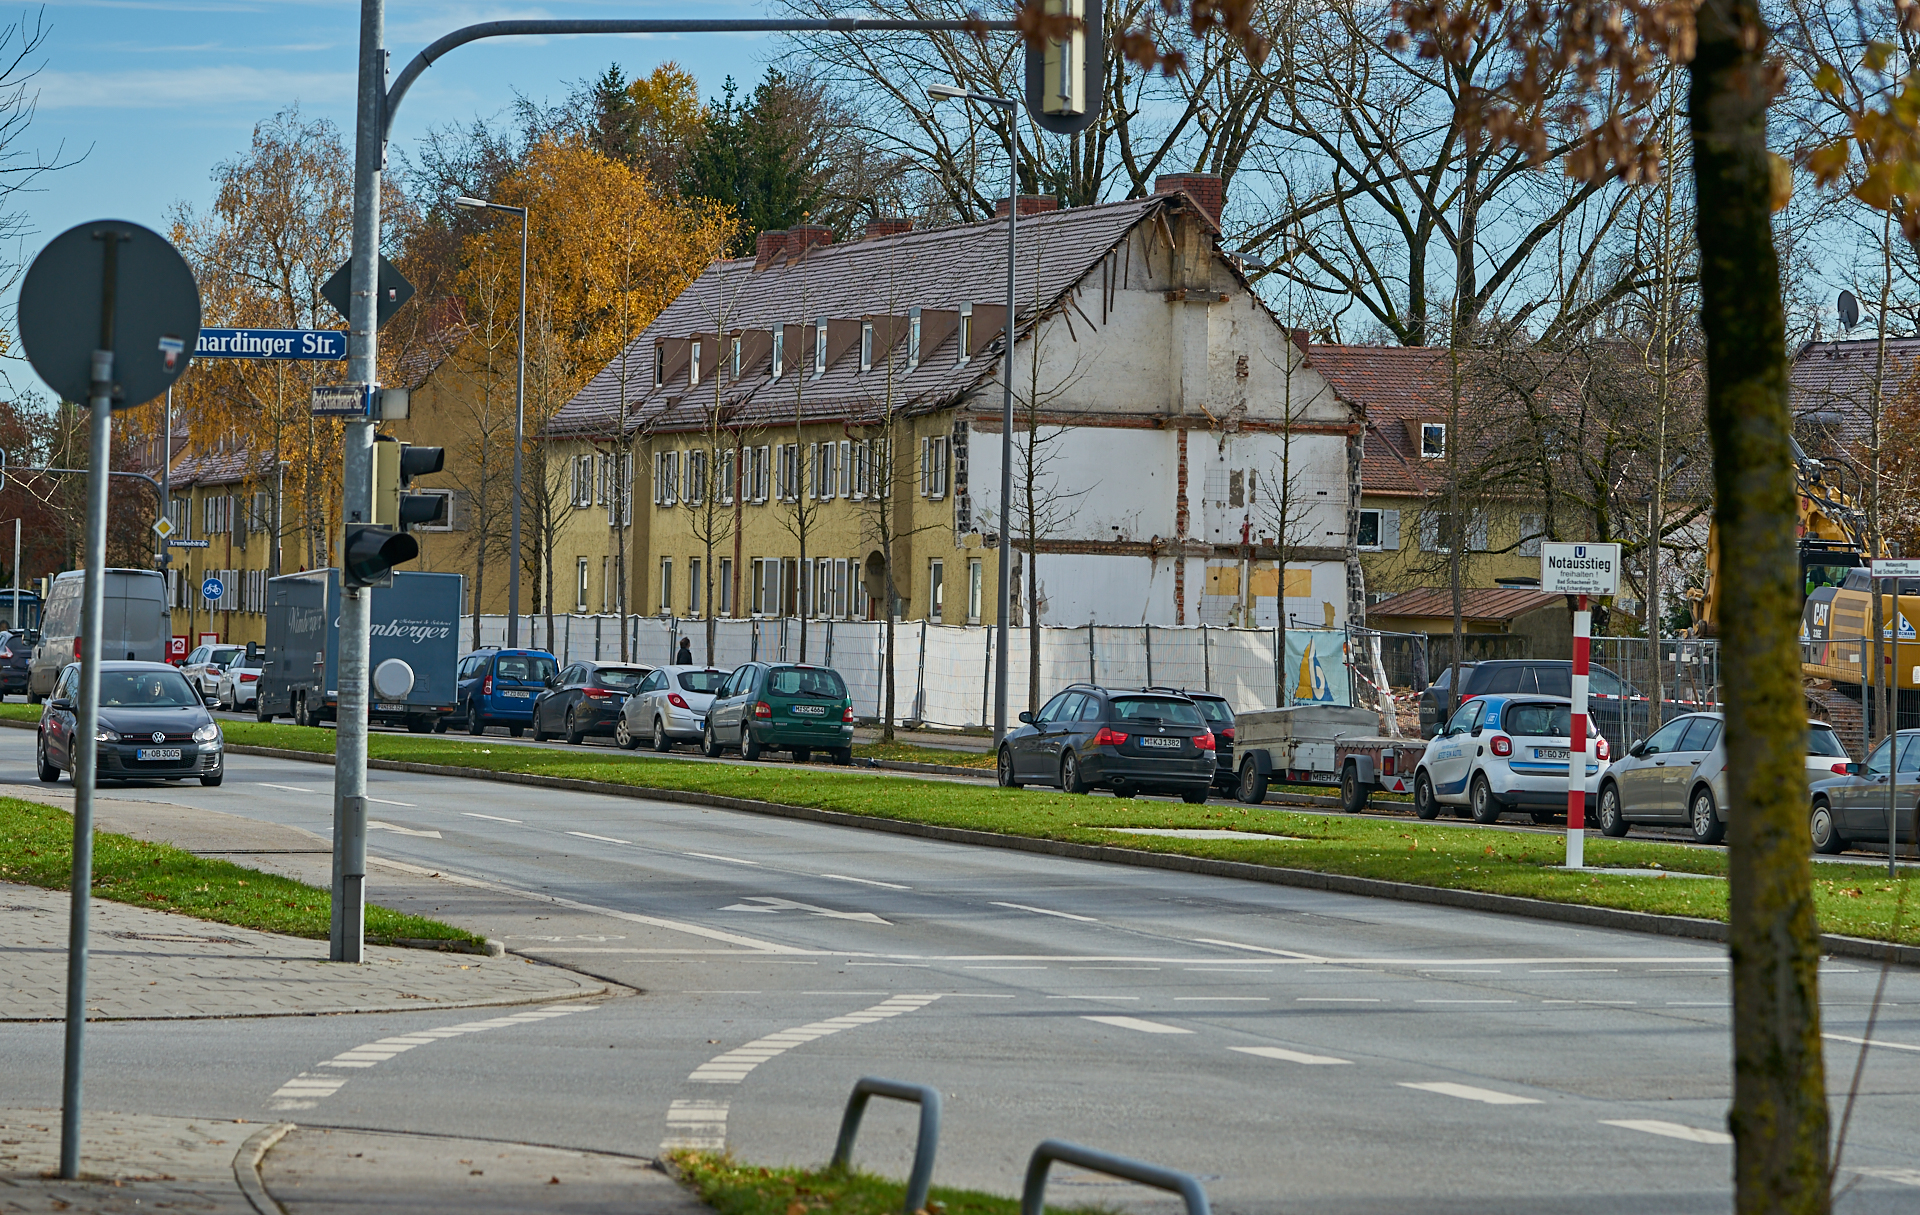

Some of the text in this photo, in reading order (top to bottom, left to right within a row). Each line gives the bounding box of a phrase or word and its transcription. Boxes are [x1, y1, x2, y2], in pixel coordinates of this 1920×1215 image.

[302, 333, 336, 354] Str.
[1549, 556, 1610, 573] Notausstieg
[1814, 602, 1829, 626] CAT
[334, 616, 450, 644] mberger
[1164, 738, 1180, 746] 1382
